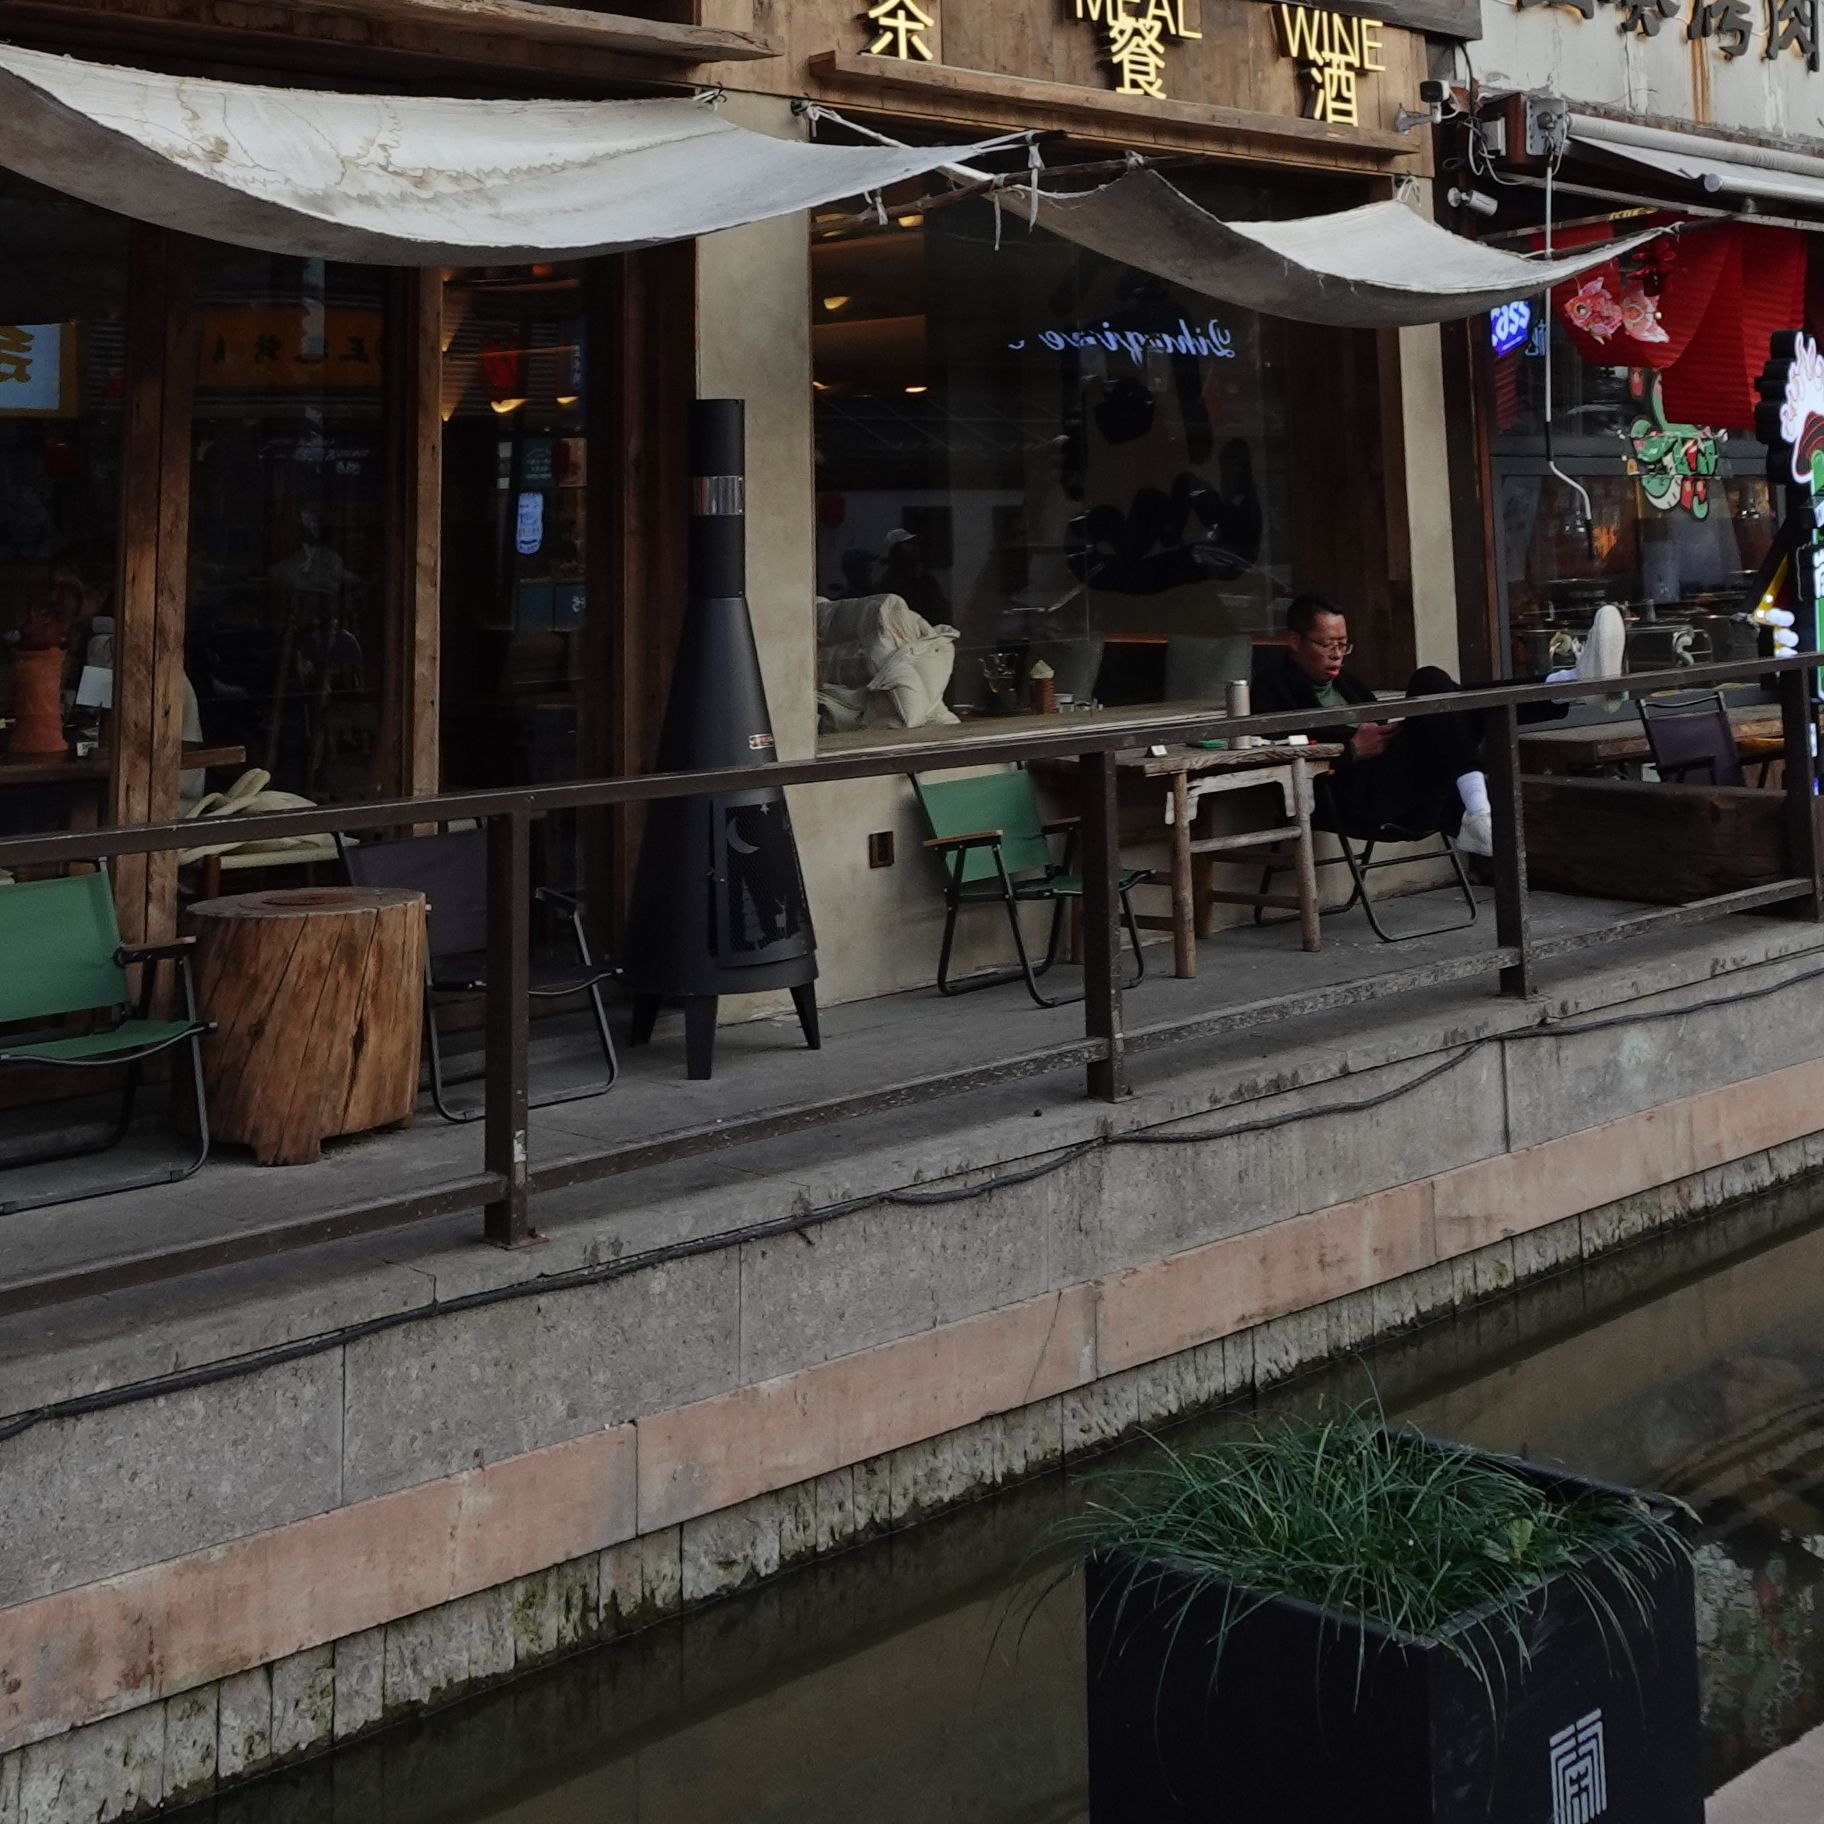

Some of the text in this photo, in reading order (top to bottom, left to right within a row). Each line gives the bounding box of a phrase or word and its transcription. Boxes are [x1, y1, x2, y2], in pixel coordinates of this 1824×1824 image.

[1108, 13, 1168, 100] 餐
[1281, 3, 1386, 72] WINE
[1310, 47, 1359, 127] 酒
